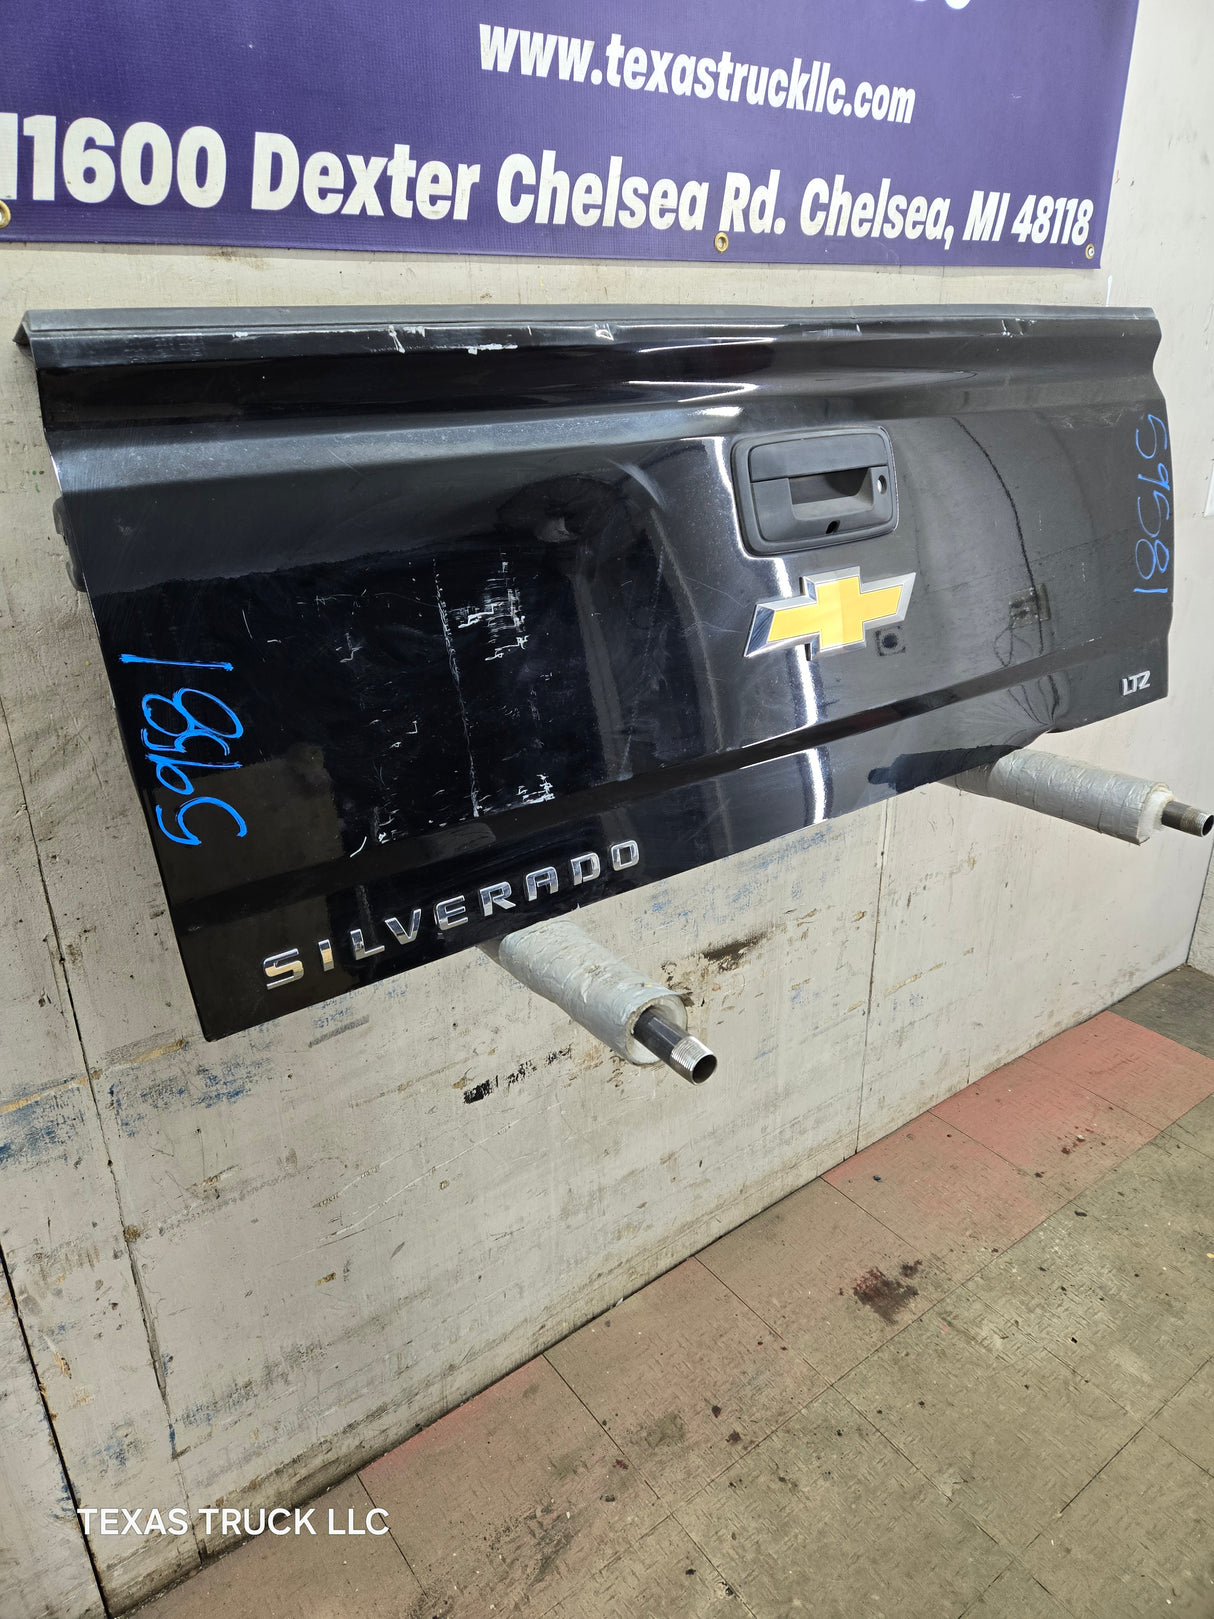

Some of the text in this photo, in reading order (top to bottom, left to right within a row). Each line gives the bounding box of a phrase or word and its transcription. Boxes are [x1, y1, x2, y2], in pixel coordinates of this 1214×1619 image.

[479, 23, 916, 124] www.texastruckllc.com
[251, 131, 481, 221] Dexter
[497, 149, 710, 232] Chelsea
[718, 169, 787, 236] Rd.
[800, 174, 954, 251] Chelsea,
[962, 190, 1011, 242] MI
[1011, 194, 1094, 246] 48118
[1133, 413, 1170, 594] 59581
[1120, 670, 1151, 696] LTZ
[262, 839, 640, 991] SILVERADO
